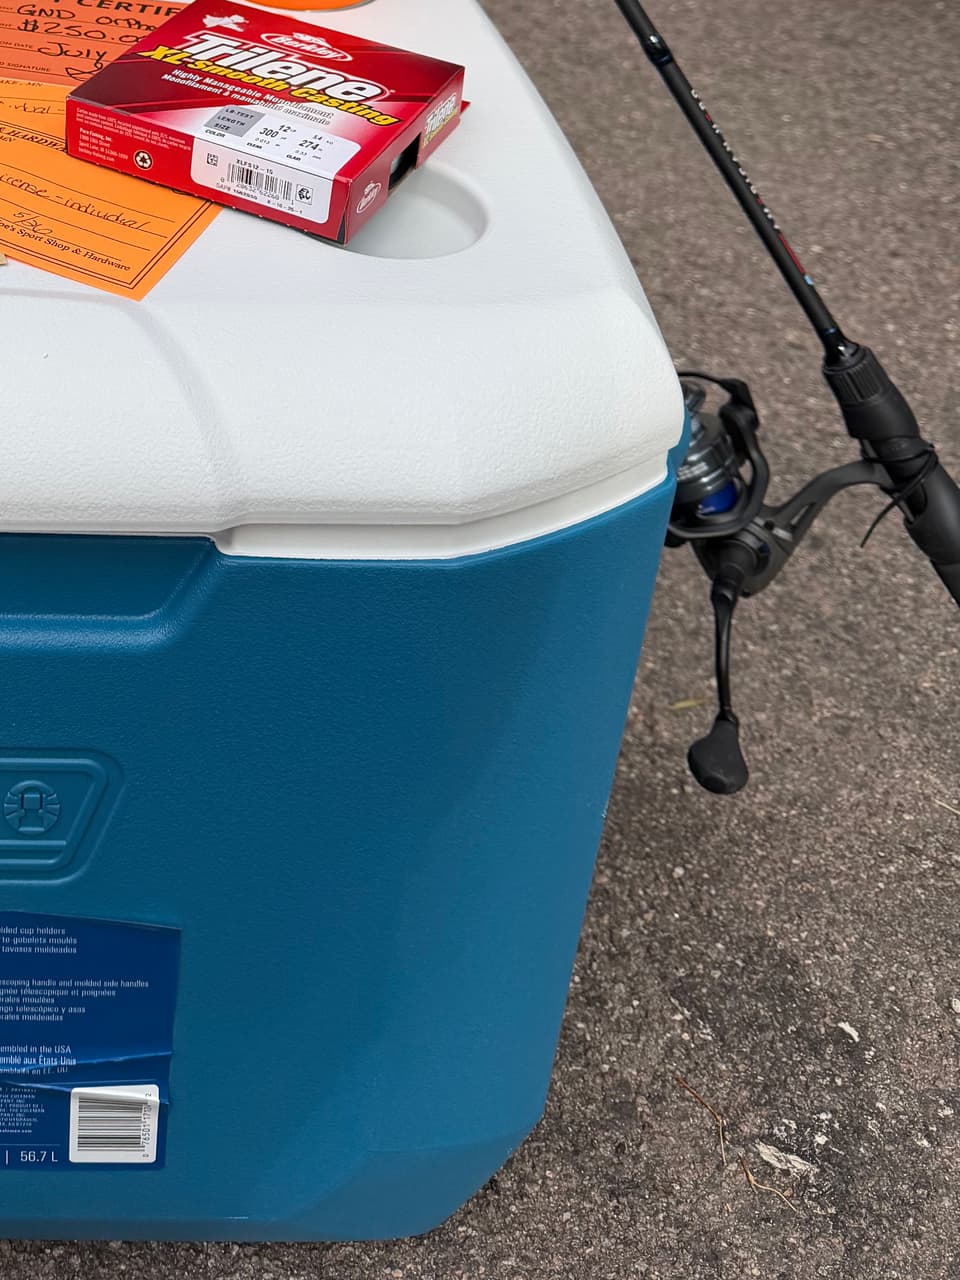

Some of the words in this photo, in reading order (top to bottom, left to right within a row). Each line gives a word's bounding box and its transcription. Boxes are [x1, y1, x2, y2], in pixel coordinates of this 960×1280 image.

[38, 41, 107, 64] July
[270, 35, 344, 60] Berkley
[182, 32, 385, 104] Trilene
[161, 73, 224, 95] Monofilament
[171, 68, 201, 84] Highly
[203, 76, 262, 99] Manageable
[189, 57, 293, 92] Smooth
[290, 85, 402, 127] Casting
[259, 127, 280, 139] 300
[298, 139, 318, 151] 274
[279, 123, 291, 133] 12
[16, 227, 43, 245] Sport
[43, 236, 70, 254] Shop
[82, 250, 132, 272] Hardware
[36, 926, 66, 935] holders
[22, 1057, 37, 1066] aux
[59, 1056, 77, 1067] Unis
[29, 1045, 39, 1054] in
[39, 1045, 53, 1055] the
[53, 1045, 72, 1055] USA
[19, 1150, 49, 1163] 56.7
[51, 1151, 59, 1163] L
